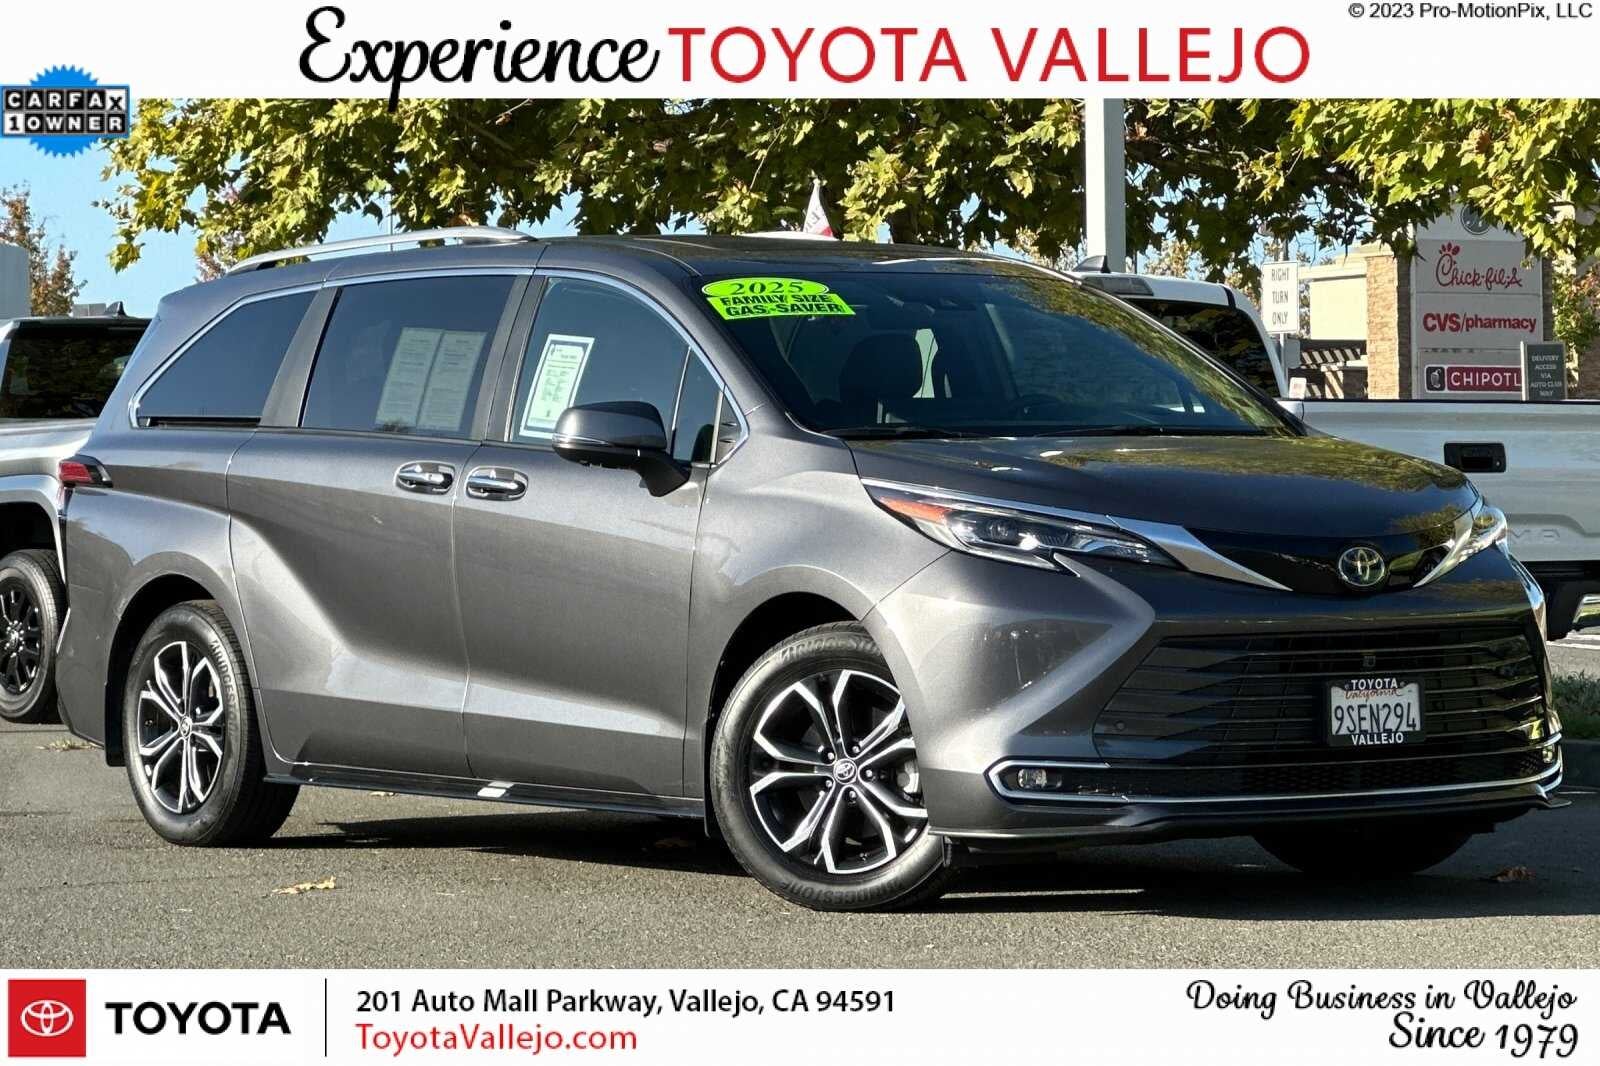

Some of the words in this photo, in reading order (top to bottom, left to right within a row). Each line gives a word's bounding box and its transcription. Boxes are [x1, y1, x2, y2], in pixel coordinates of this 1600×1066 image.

[1271, 268, 1289, 281] RIGHT
[1436, 248, 1522, 290] Chick-fil-A
[730, 281, 803, 295] 2025
[720, 294, 786, 306] FAMILY
[793, 293, 832, 303] SIZE
[1272, 291, 1289, 304] TURN
[1272, 312, 1288, 325] ONLY
[1423, 312, 1537, 333] CVS/pharmacy
[1450, 371, 1521, 387] CHIPOTL
[1351, 678, 1398, 690] TOYOTA
[1334, 702, 1417, 734] 9SEN294
[1351, 732, 1404, 746] VALLEJO
